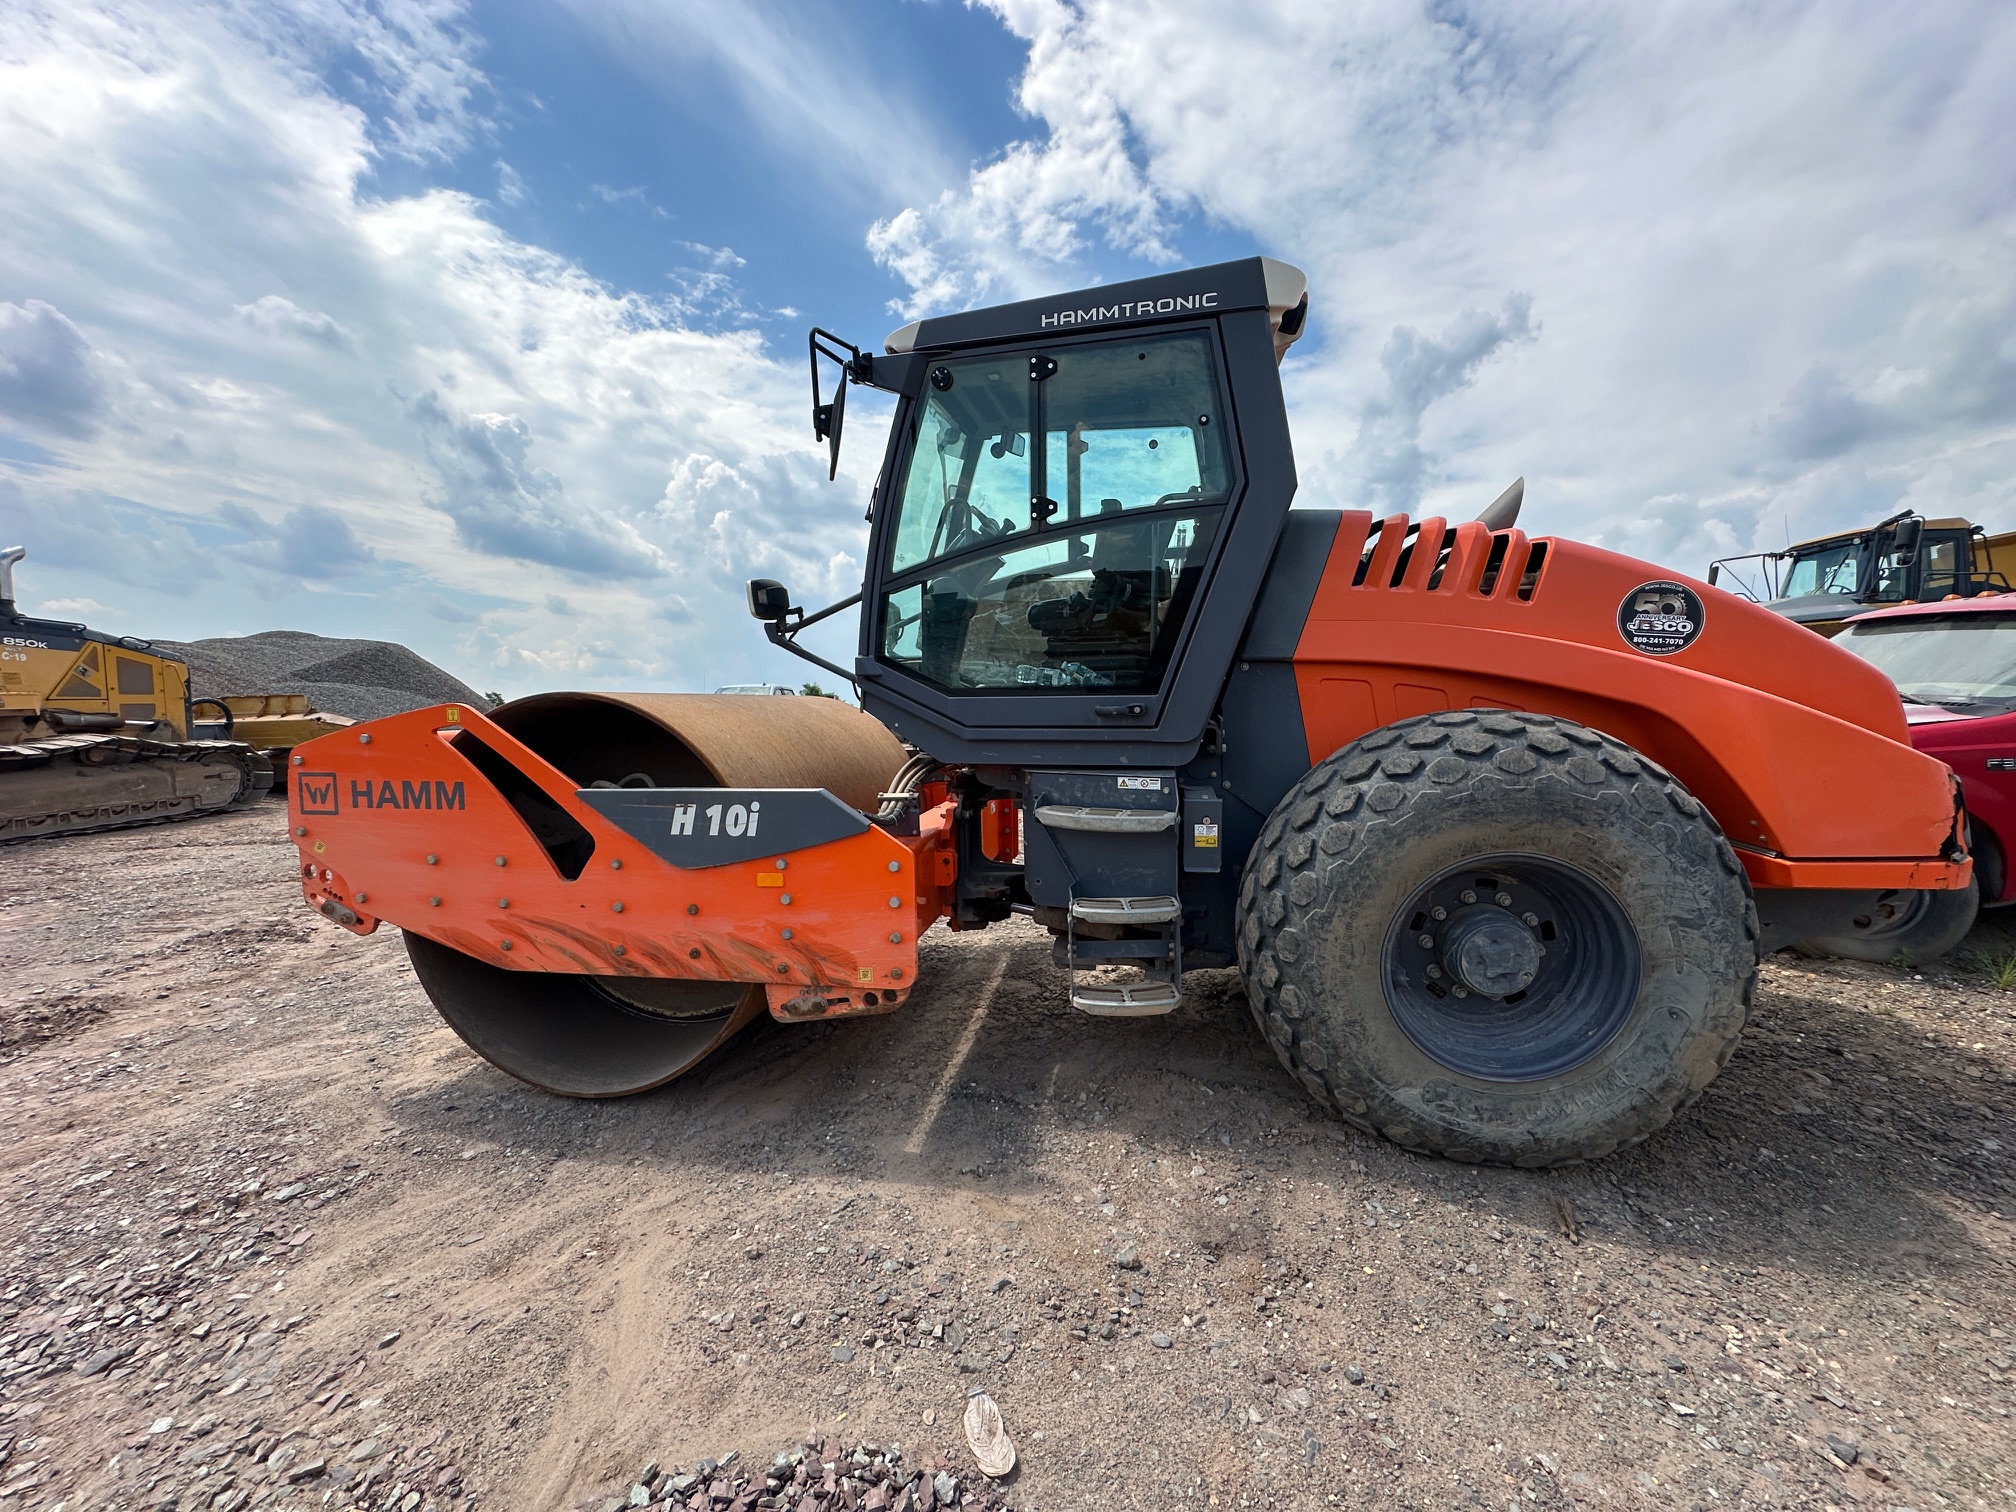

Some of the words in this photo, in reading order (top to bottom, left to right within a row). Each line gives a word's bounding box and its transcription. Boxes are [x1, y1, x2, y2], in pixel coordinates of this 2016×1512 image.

[1041, 292, 1218, 328] HAMMTRONIC
[1629, 620, 1691, 632] JESCO
[2, 637, 48, 649] 850K
[1633, 636, 1684, 645] 800-241-7070
[2, 651, 27, 661] C-19
[1986, 758, 2016, 768] F3
[351, 780, 466, 810] HAMM
[670, 803, 697, 835] H
[705, 801, 760, 837] 10i
